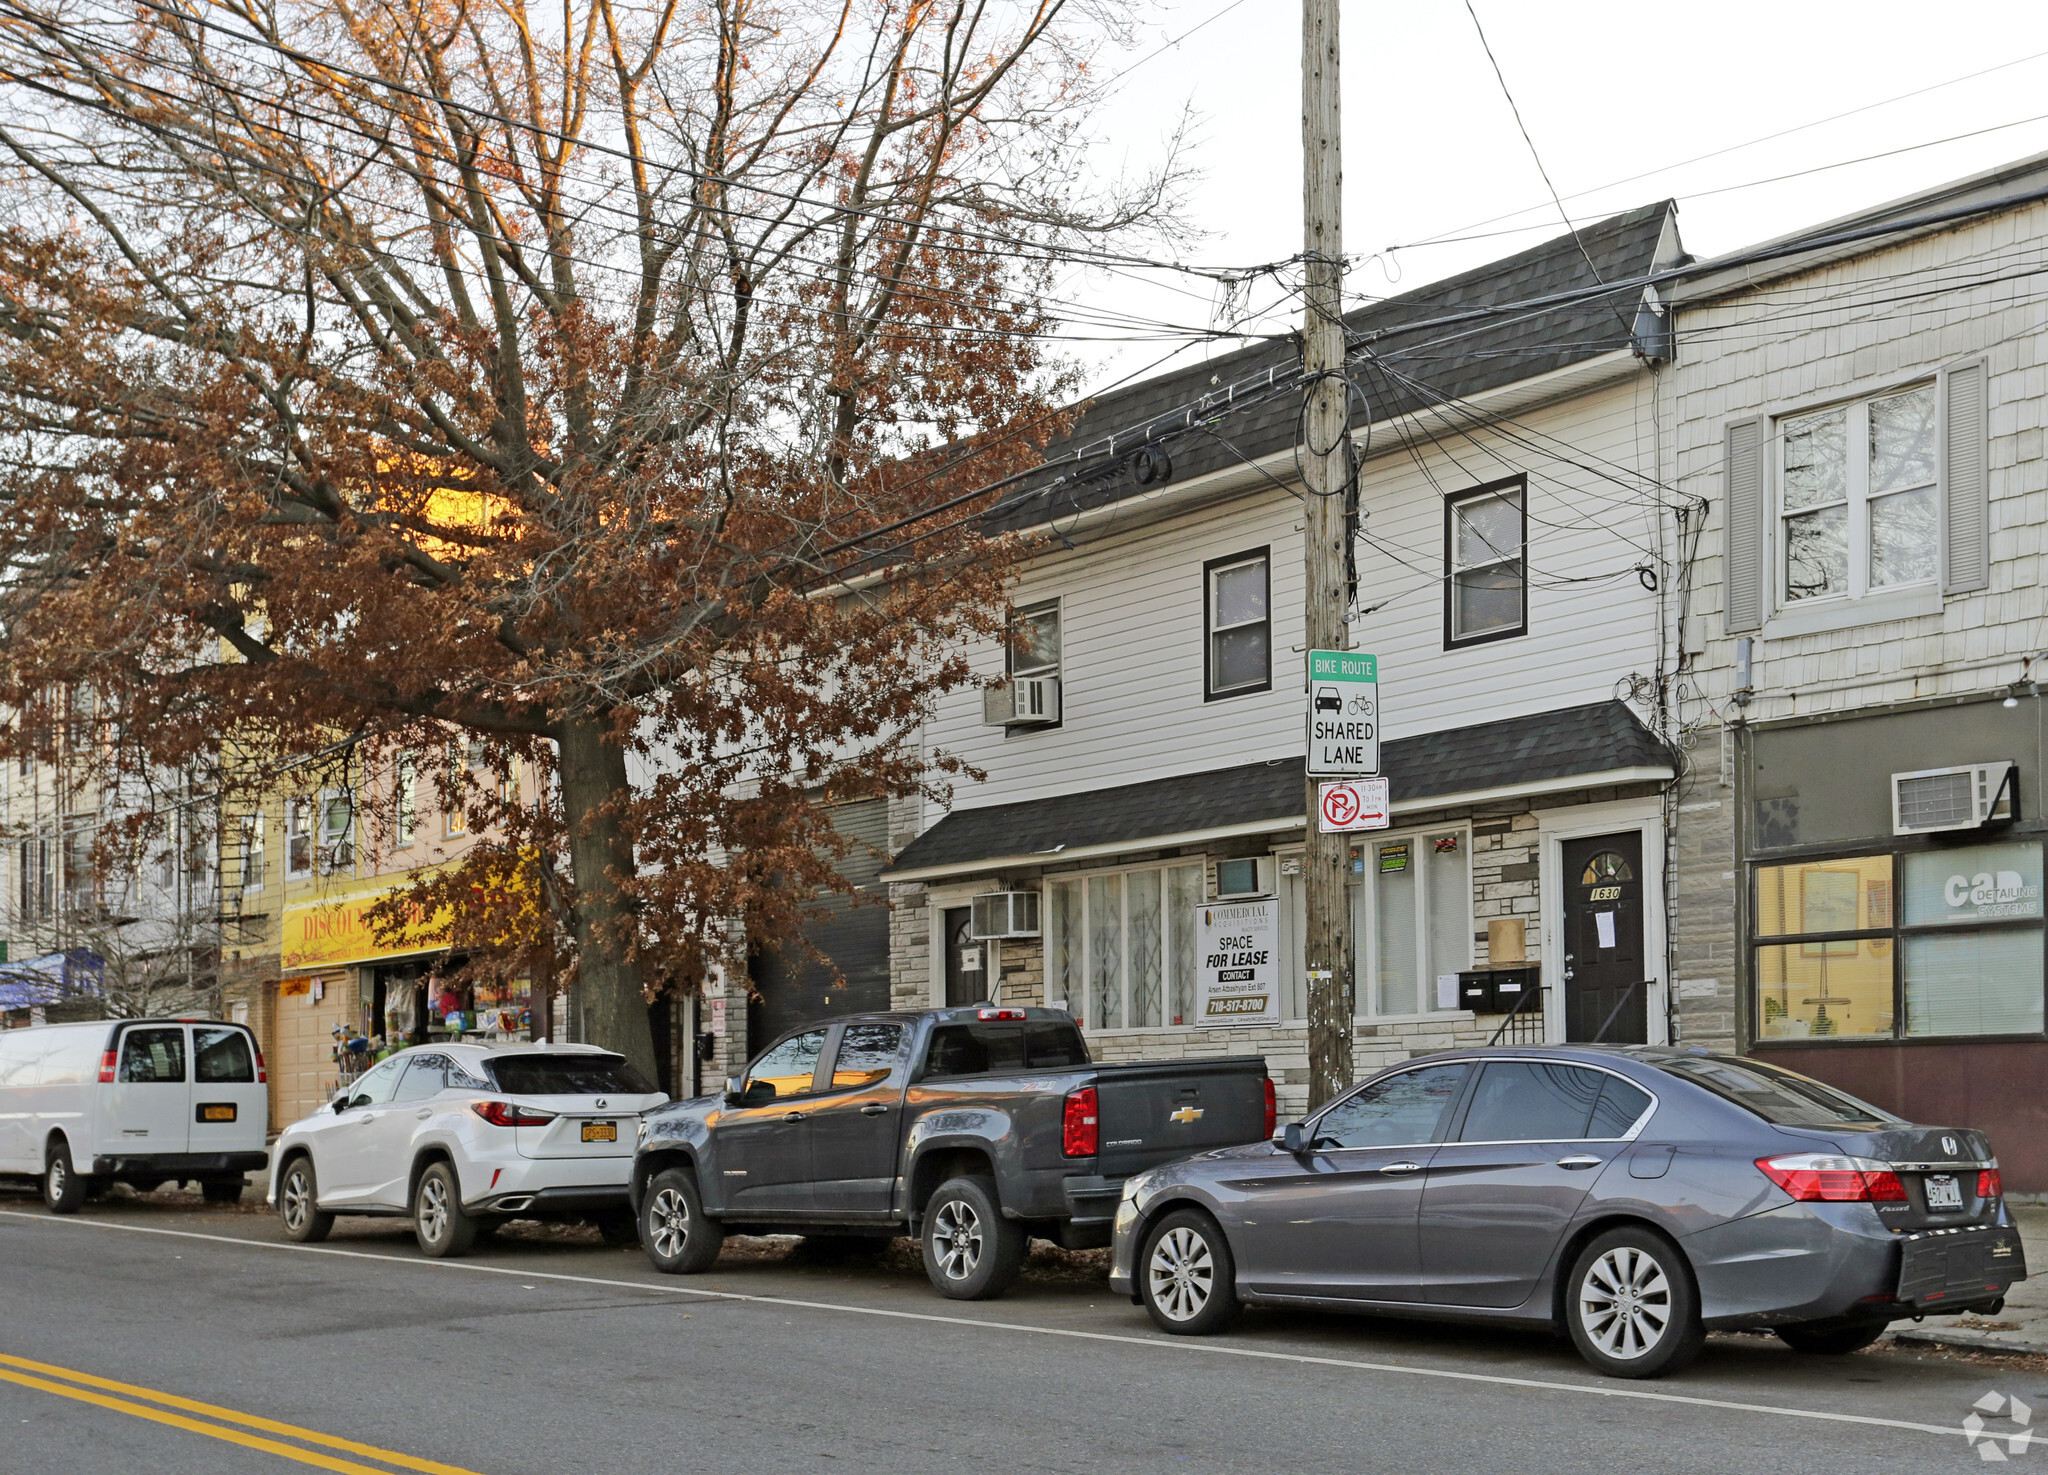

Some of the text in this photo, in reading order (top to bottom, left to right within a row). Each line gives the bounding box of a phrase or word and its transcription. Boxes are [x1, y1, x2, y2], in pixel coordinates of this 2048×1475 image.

[1315, 659, 1373, 676] BIKE ROUTE
[1315, 721, 1374, 740] SHARED
[1324, 745, 1363, 764] LANE
[1594, 888, 1619, 899] 1630
[1977, 885, 2038, 901] DETAILING
[1213, 905, 1269, 921] COMMERCIAL
[1978, 901, 2038, 917] SYSTEMS
[1213, 917, 1268, 928] ACQUISITIONS
[1219, 935, 1253, 951] SPACE
[1206, 951, 1269, 968] FOR LEASE
[1222, 970, 1250, 981] CONTACT
[1247, 983, 1256, 991] Ext
[1257, 982, 1266, 990] 807
[1210, 998, 1264, 1013] 718-517-8700
[1106, 1139, 1142, 1147] COLORADO
